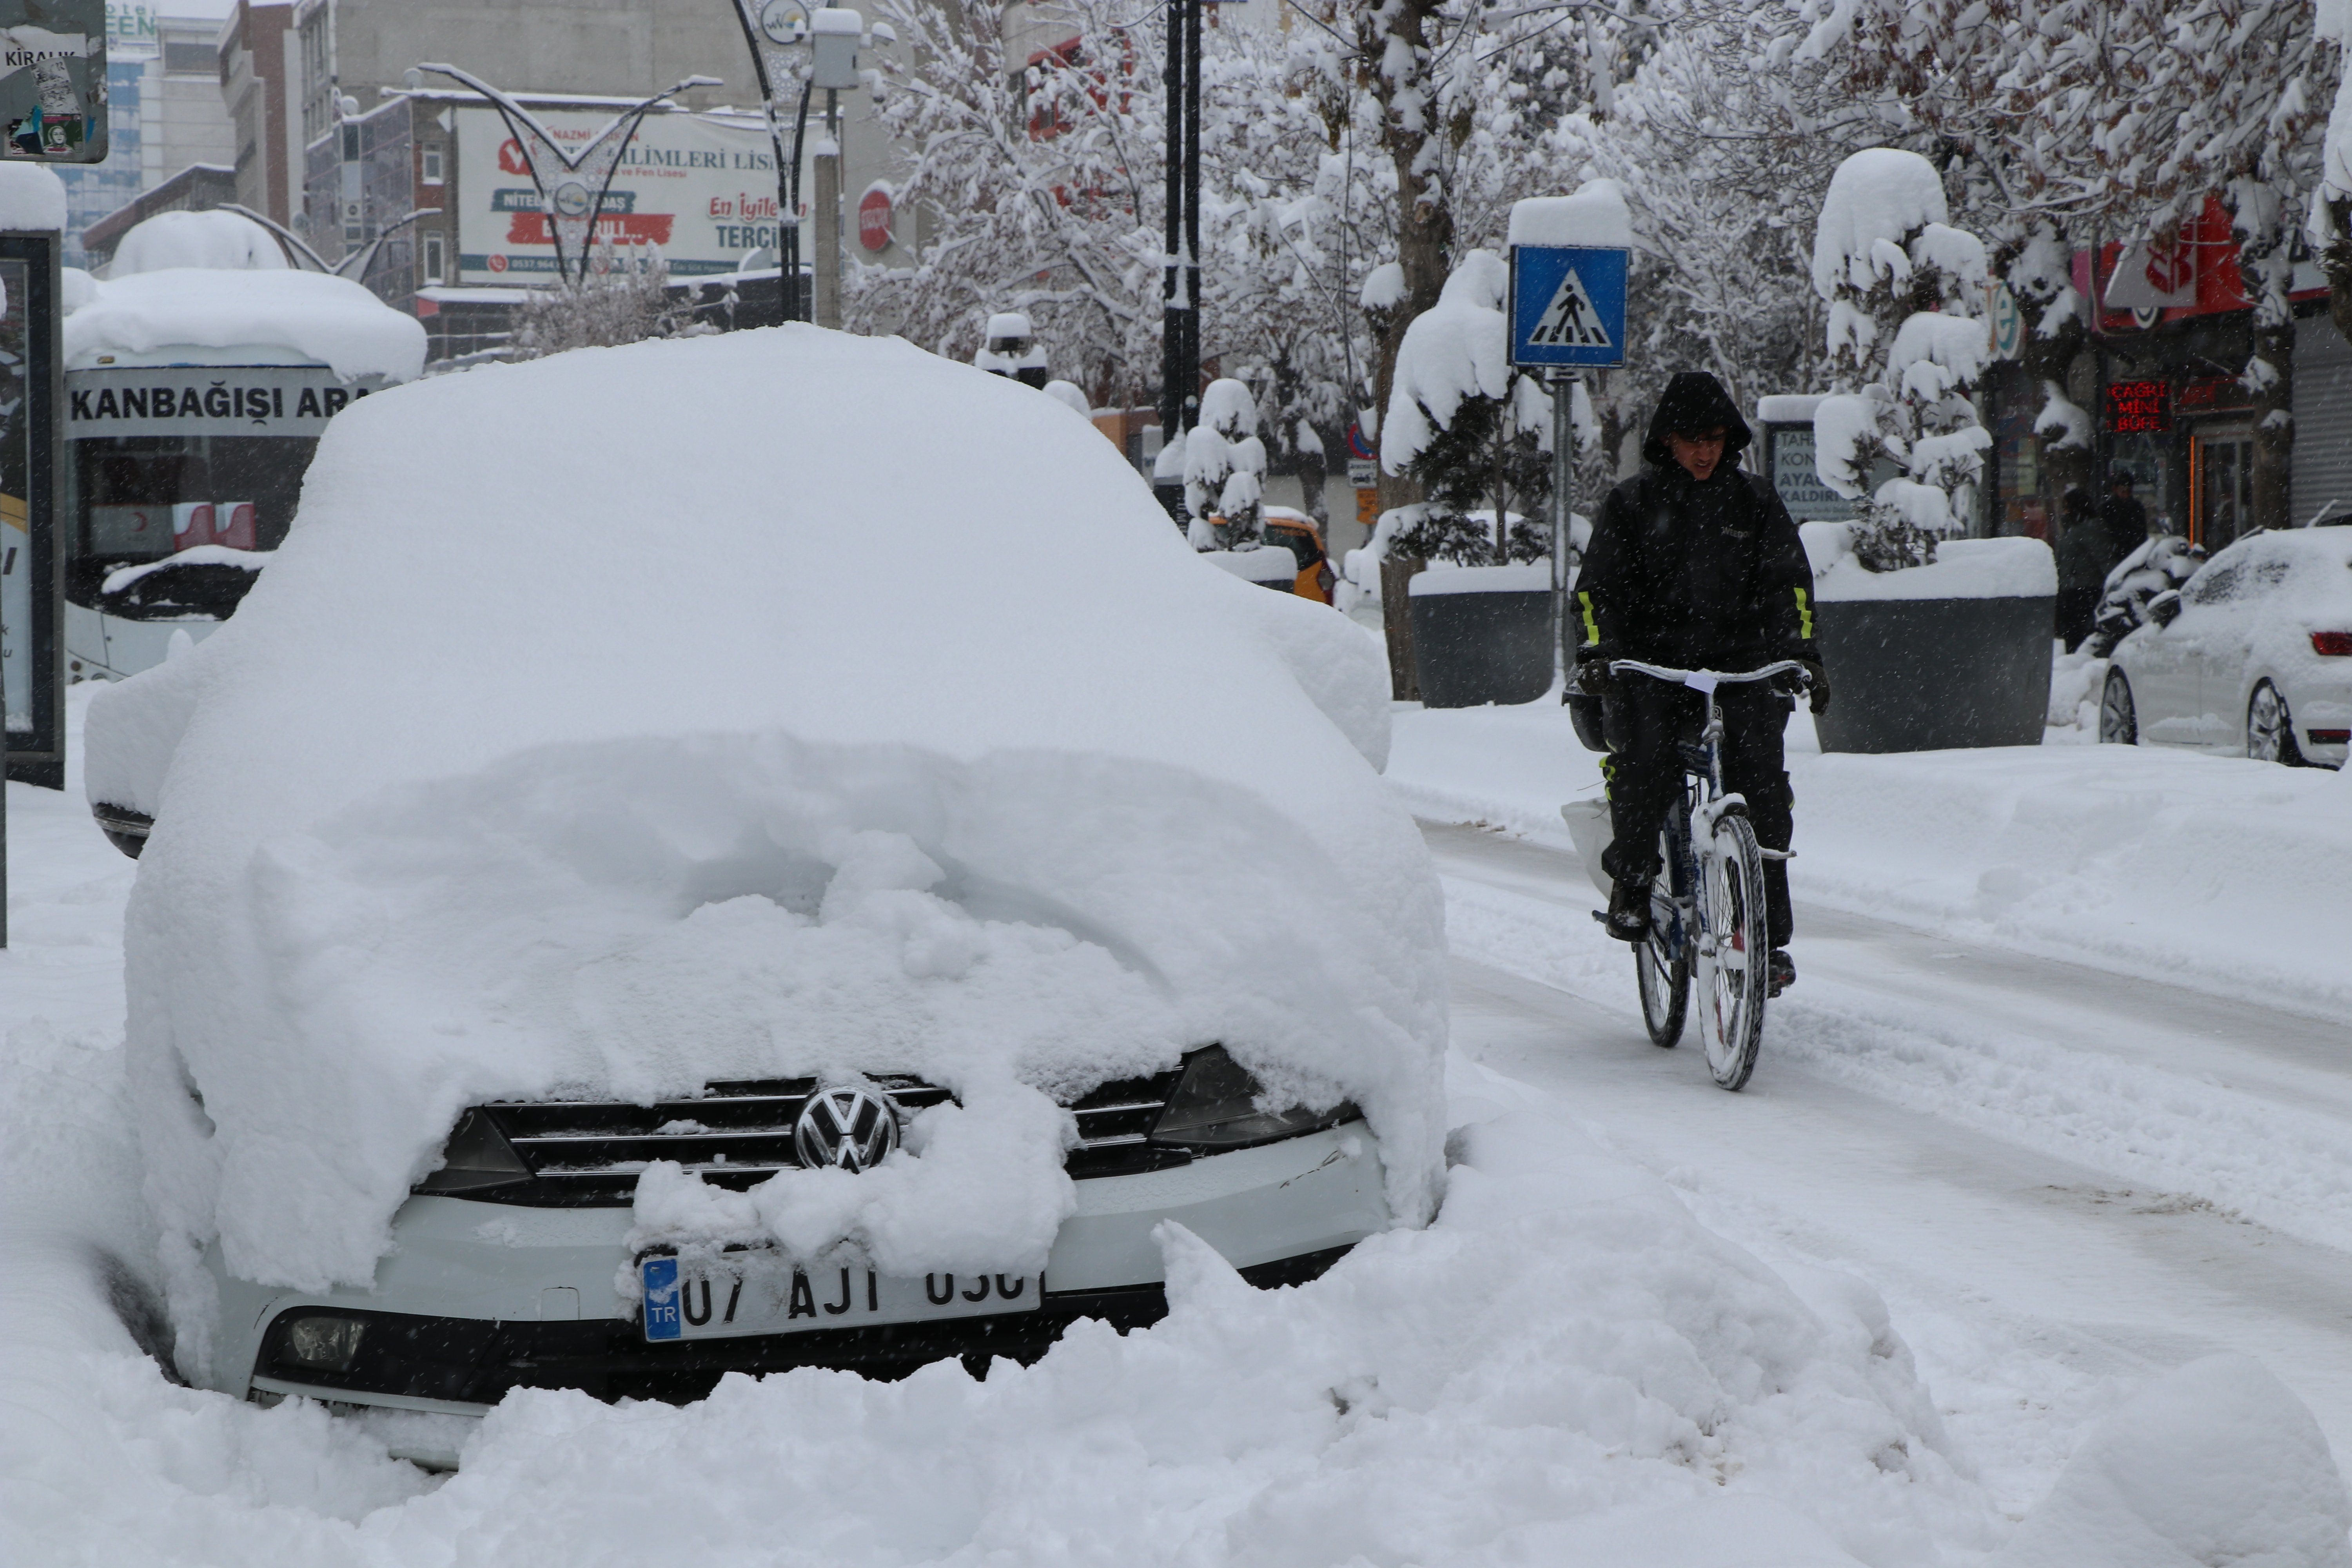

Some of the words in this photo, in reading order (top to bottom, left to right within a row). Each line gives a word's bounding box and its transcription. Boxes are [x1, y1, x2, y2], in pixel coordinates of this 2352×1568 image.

[105, 16, 155, 36] EEN
[503, 193, 542, 207] NİTEL
[71, 380, 283, 426] KANBAĞIŞI
[1781, 433, 1816, 446] TAH
[1782, 453, 1816, 466] KON
[1780, 490, 1840, 502] KALDIRI
[651, 1305, 676, 1323] TR
